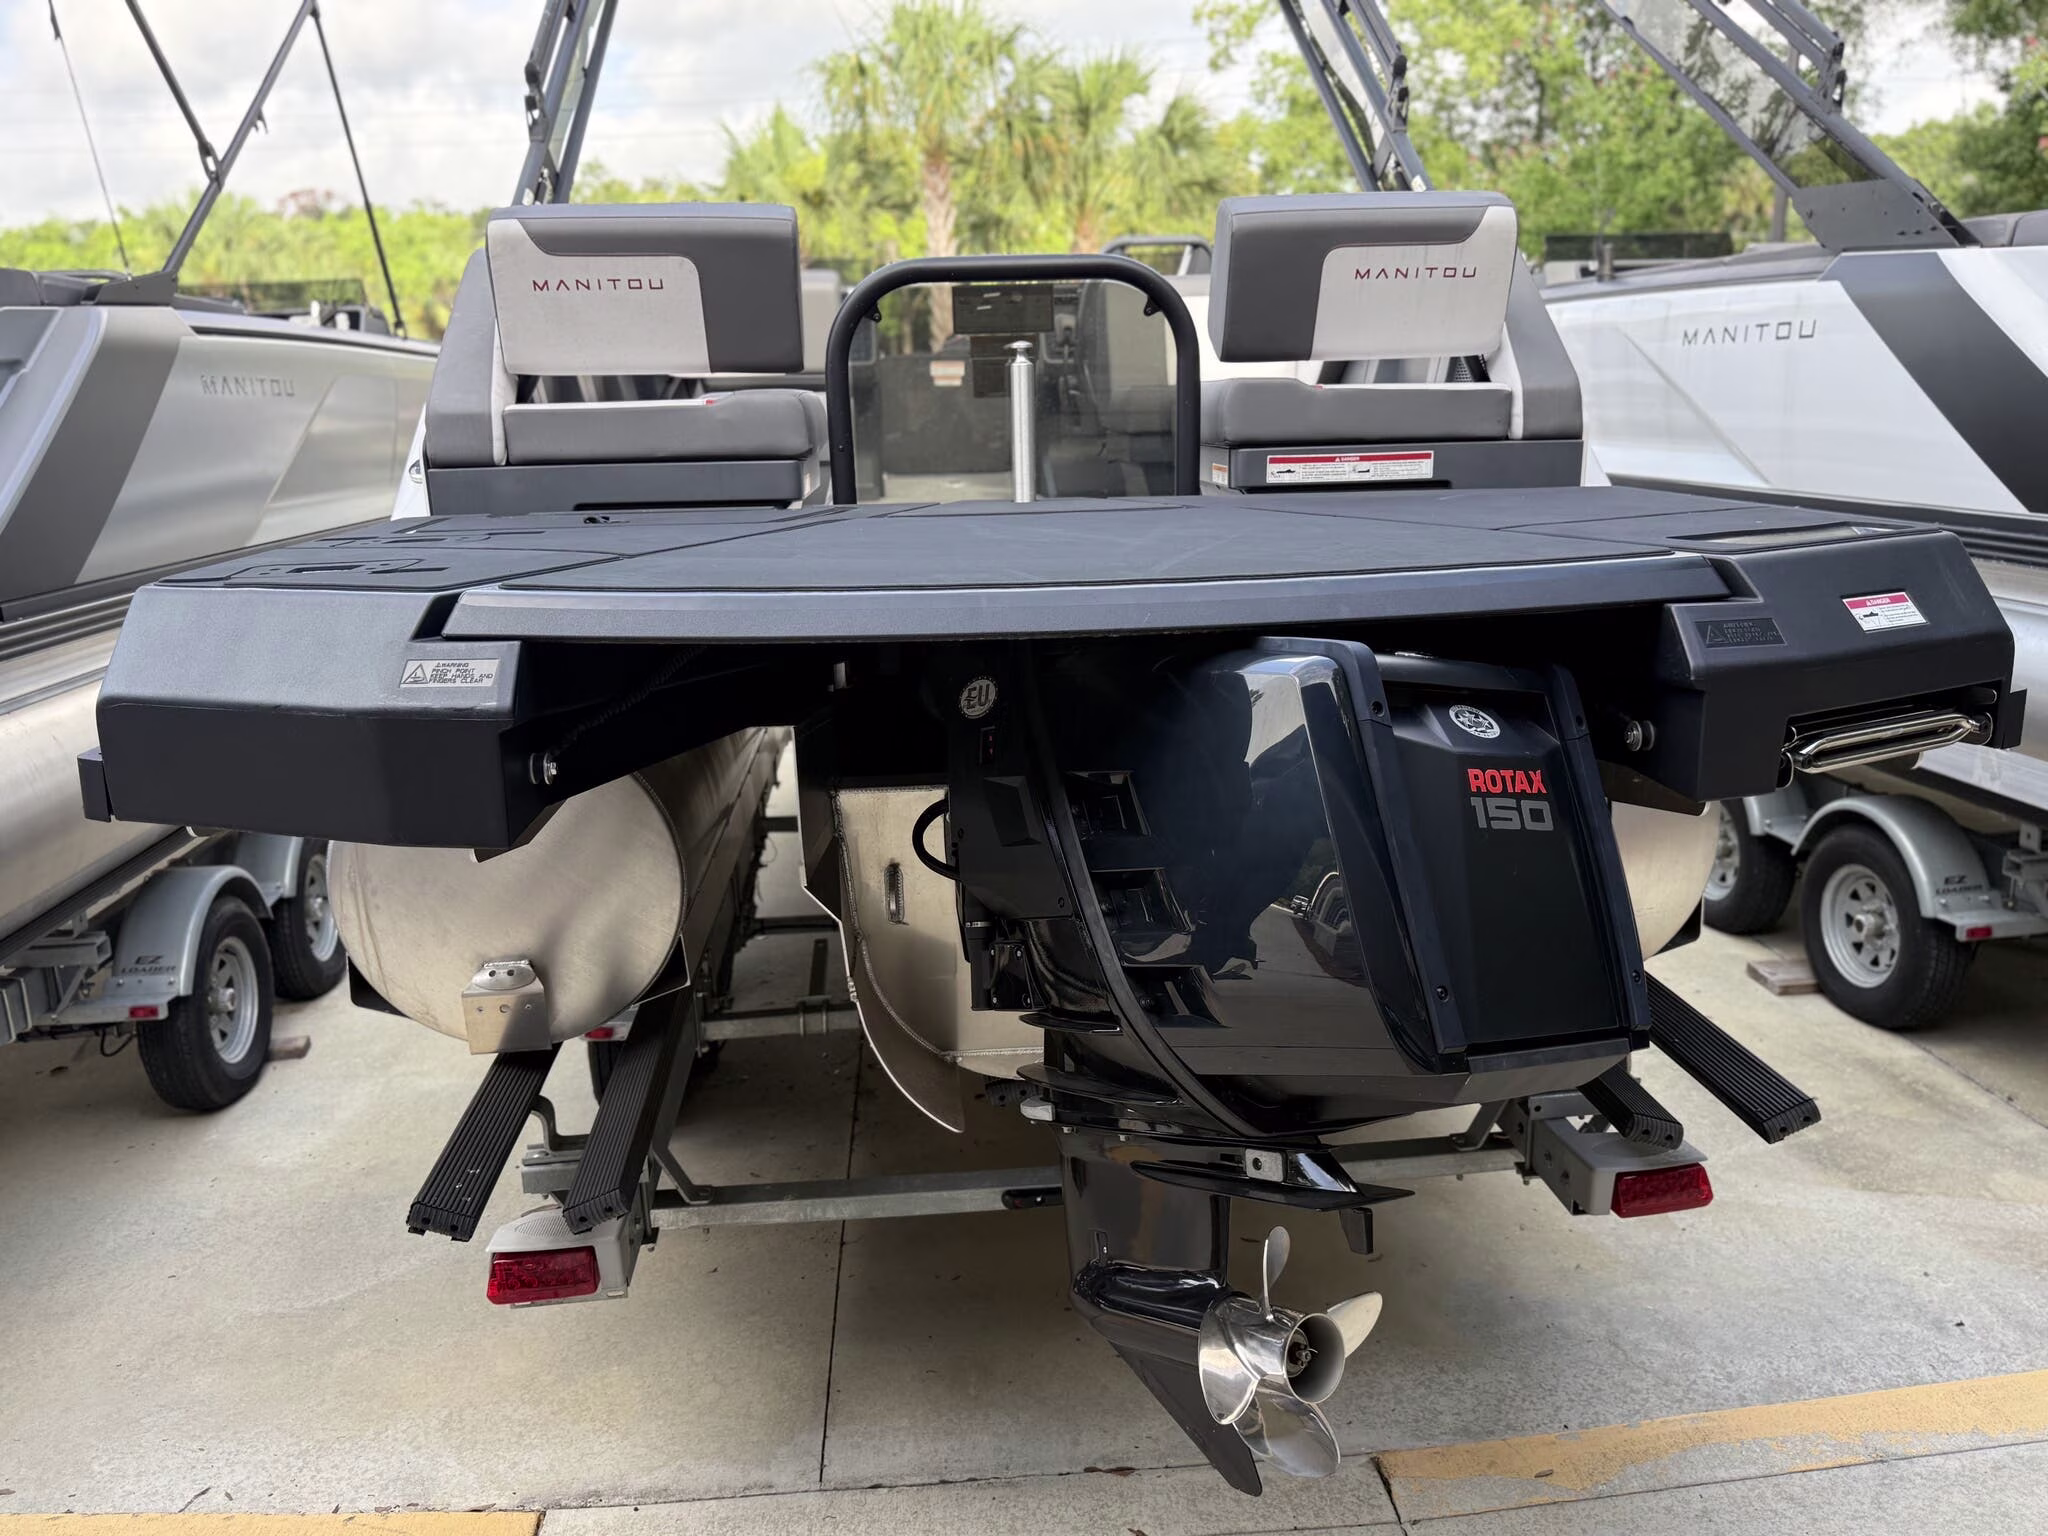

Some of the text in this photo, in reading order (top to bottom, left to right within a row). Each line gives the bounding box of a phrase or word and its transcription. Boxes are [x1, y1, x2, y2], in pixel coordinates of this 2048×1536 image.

[532, 278, 664, 292] MANITOU
[1354, 267, 1477, 280] MANITOU
[1682, 319, 1817, 347] MANITOU
[200, 375, 295, 397] MANITOU
[1467, 768, 1548, 795] ROTAX
[1470, 797, 1555, 831] 150
